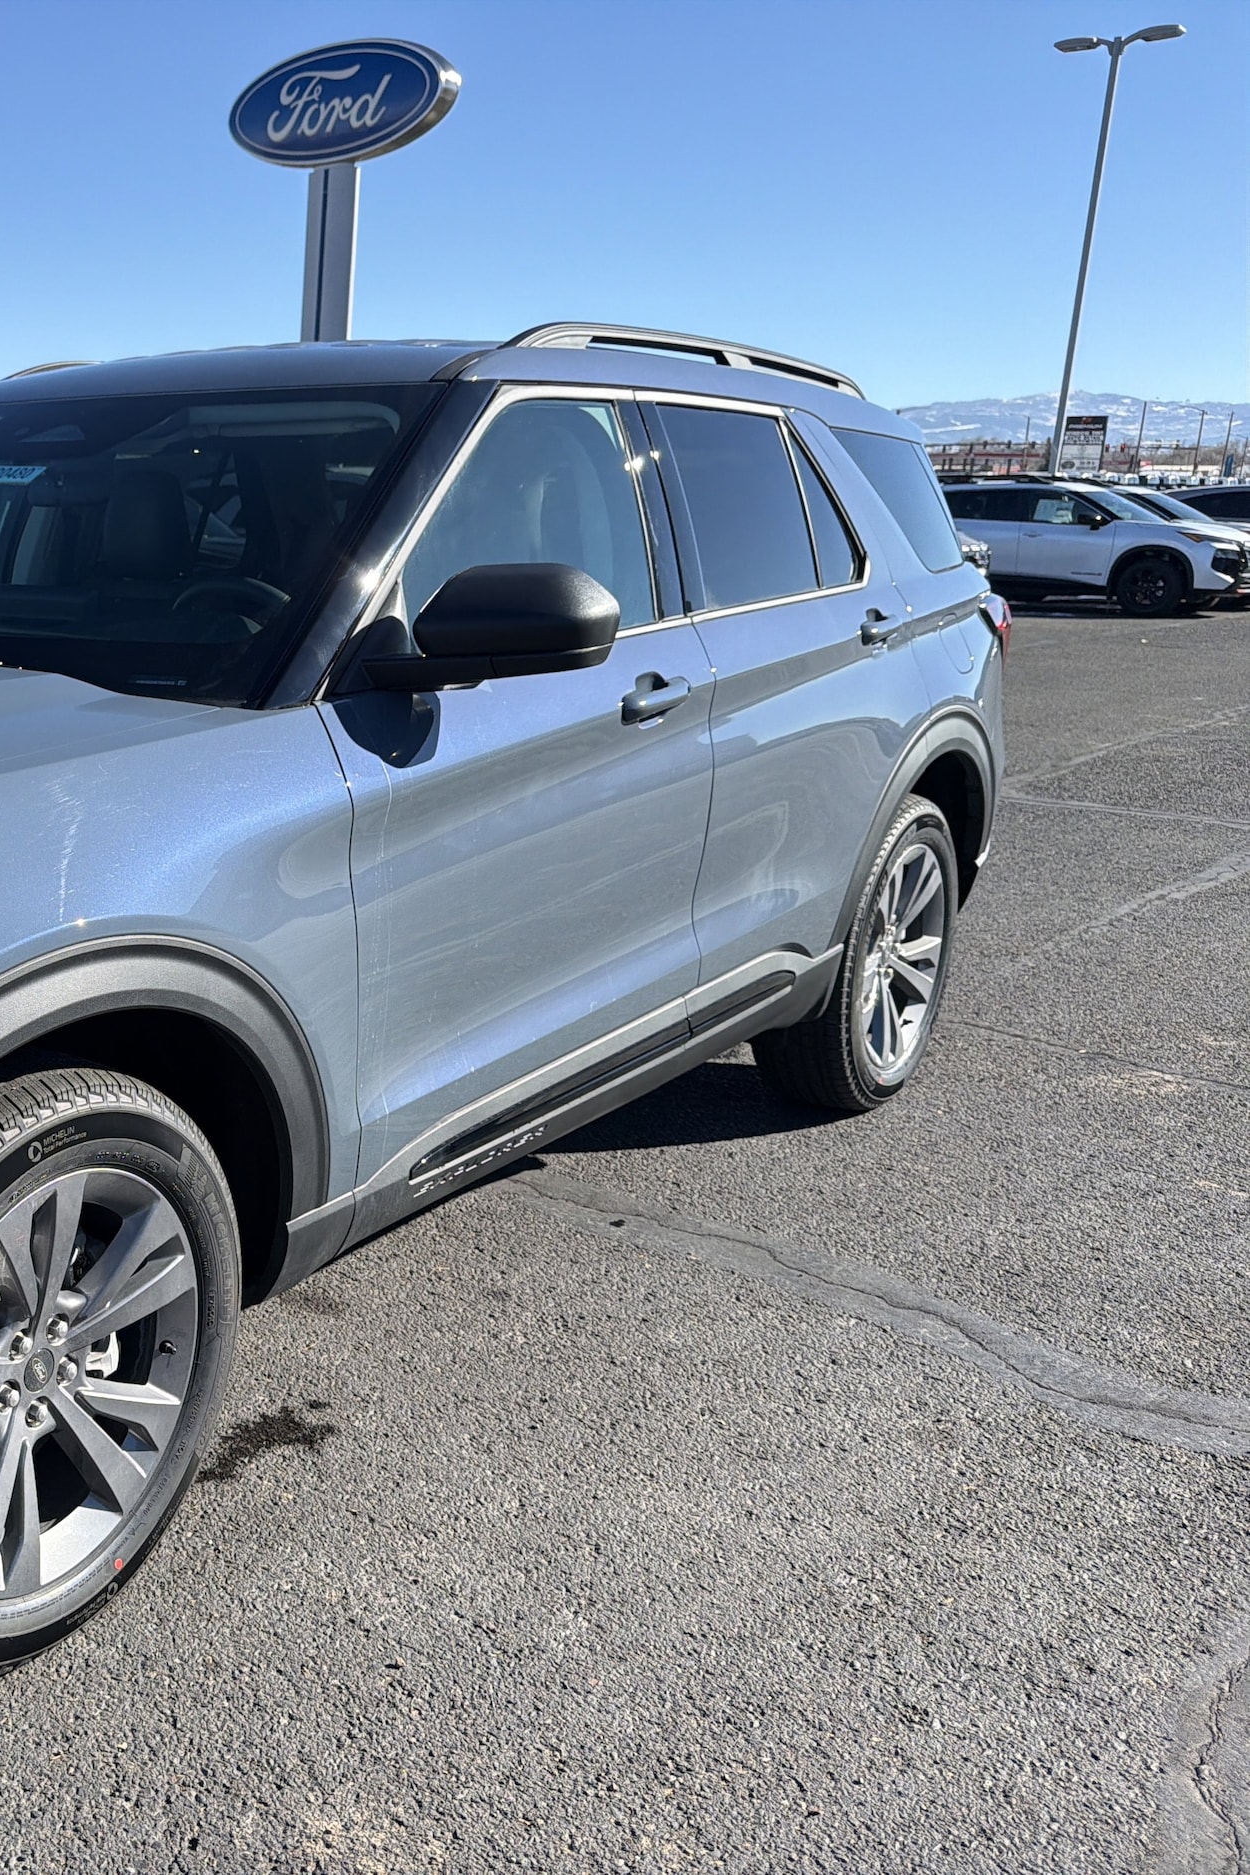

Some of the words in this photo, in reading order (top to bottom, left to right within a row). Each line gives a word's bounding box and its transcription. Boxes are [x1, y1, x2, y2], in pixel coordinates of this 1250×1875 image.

[267, 63, 392, 142] Ford
[43, 1126, 75, 1147] MICHELIN
[204, 1191, 236, 1320] MICHELIN
